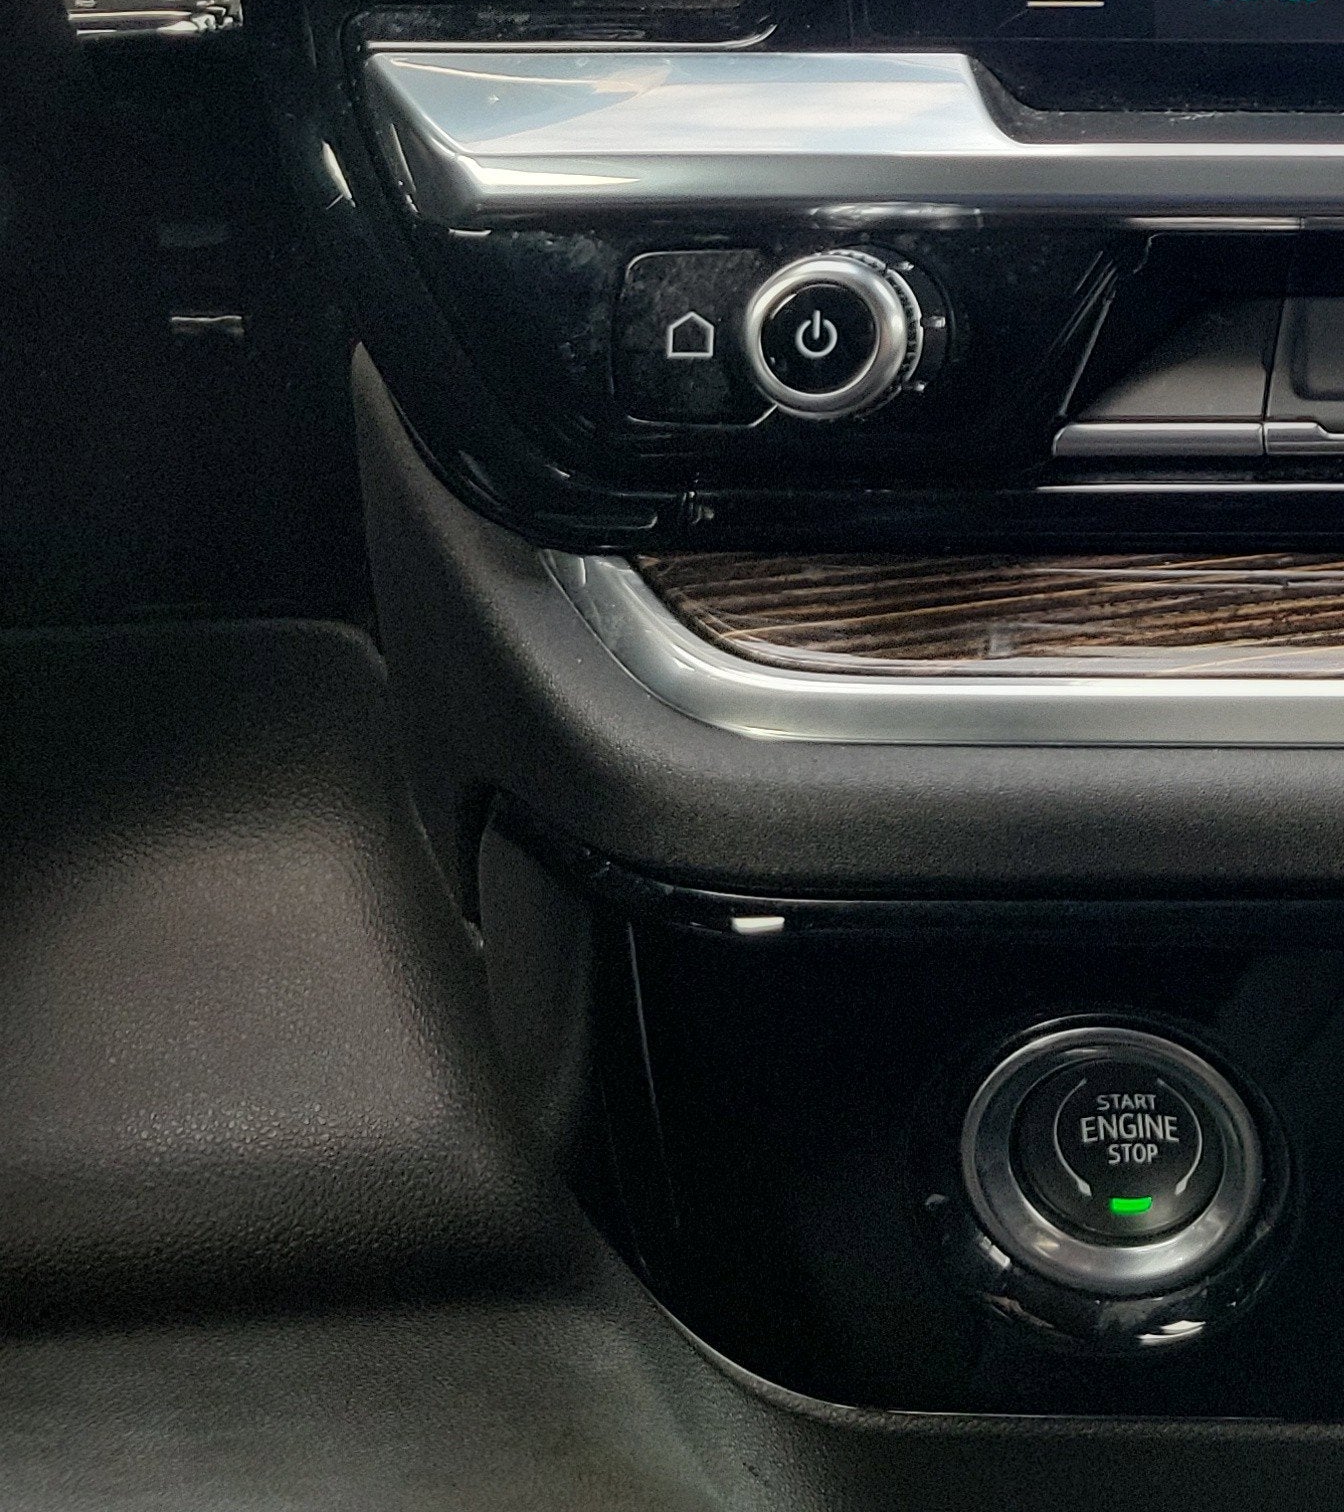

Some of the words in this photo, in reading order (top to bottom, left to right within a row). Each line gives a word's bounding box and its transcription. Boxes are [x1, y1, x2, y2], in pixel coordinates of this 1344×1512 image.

[1096, 1093, 1156, 1111] START
[1081, 1114, 1180, 1143] ENGINE
[1108, 1143, 1159, 1165] STOP
